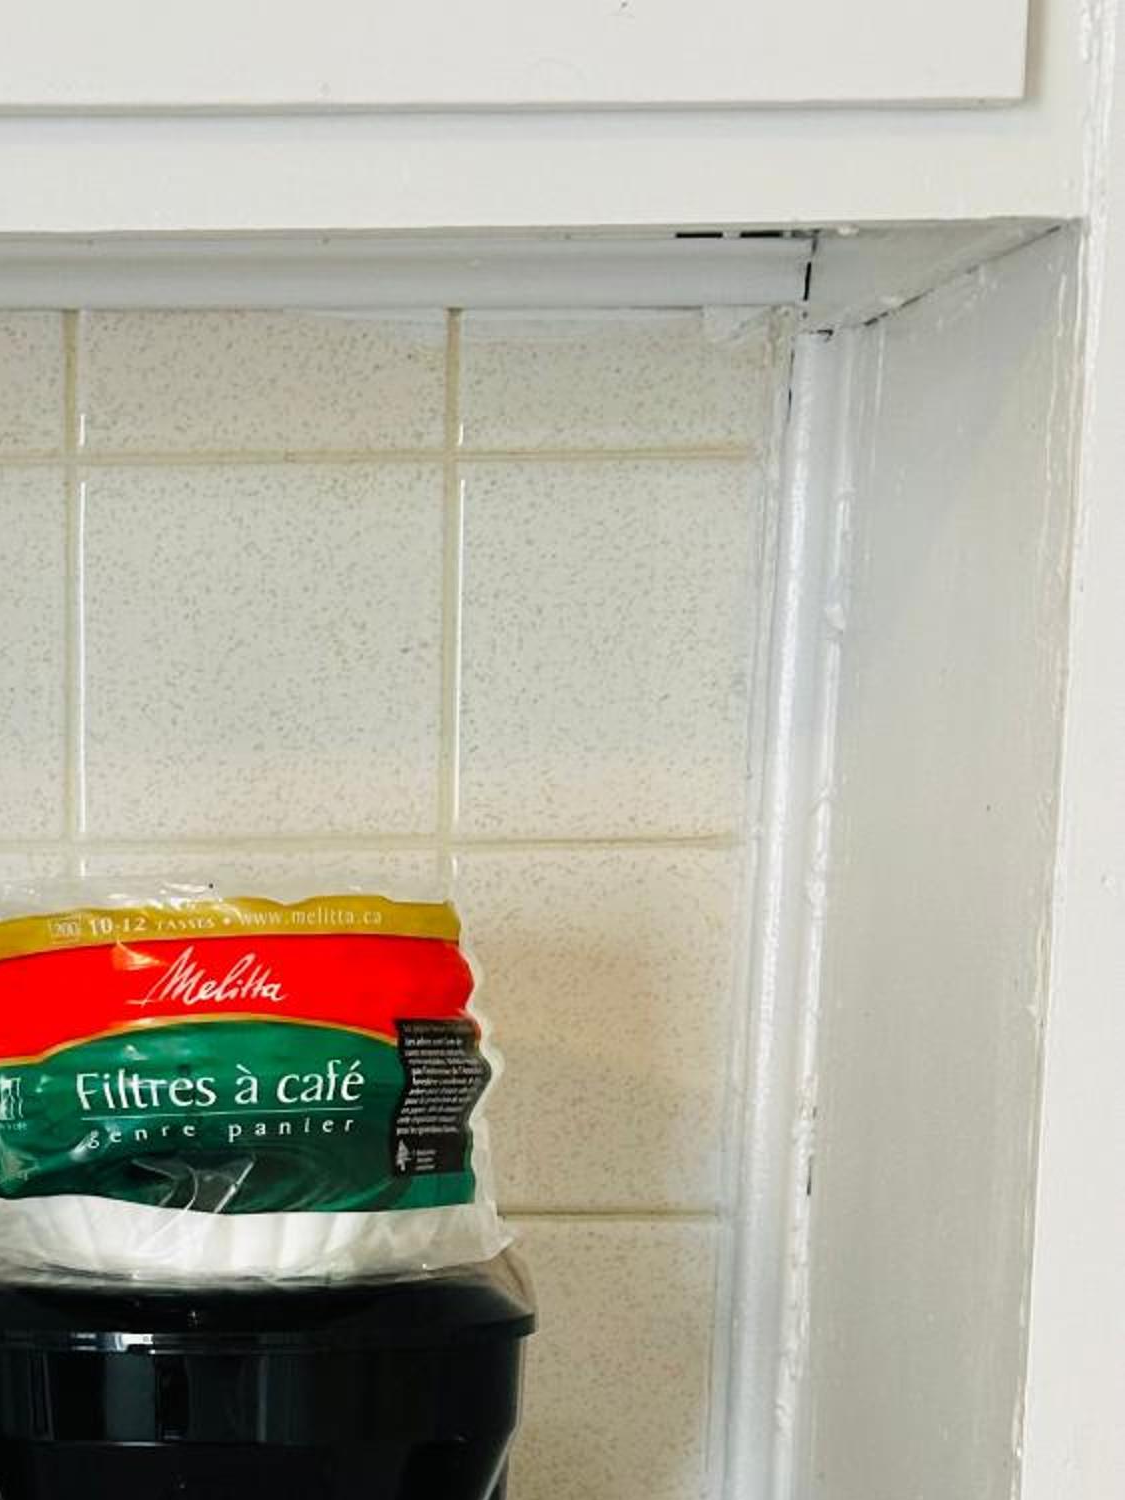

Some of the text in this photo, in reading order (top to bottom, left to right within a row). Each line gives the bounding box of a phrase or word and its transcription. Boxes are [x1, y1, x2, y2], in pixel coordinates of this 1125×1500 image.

[89, 914, 148, 937] 10-12
[239, 906, 383, 926] www.melitta.ca
[125, 945, 289, 1006] Melitta
[76, 1059, 365, 1110] Filtres à café
[87, 1117, 355, 1149] genre panier
